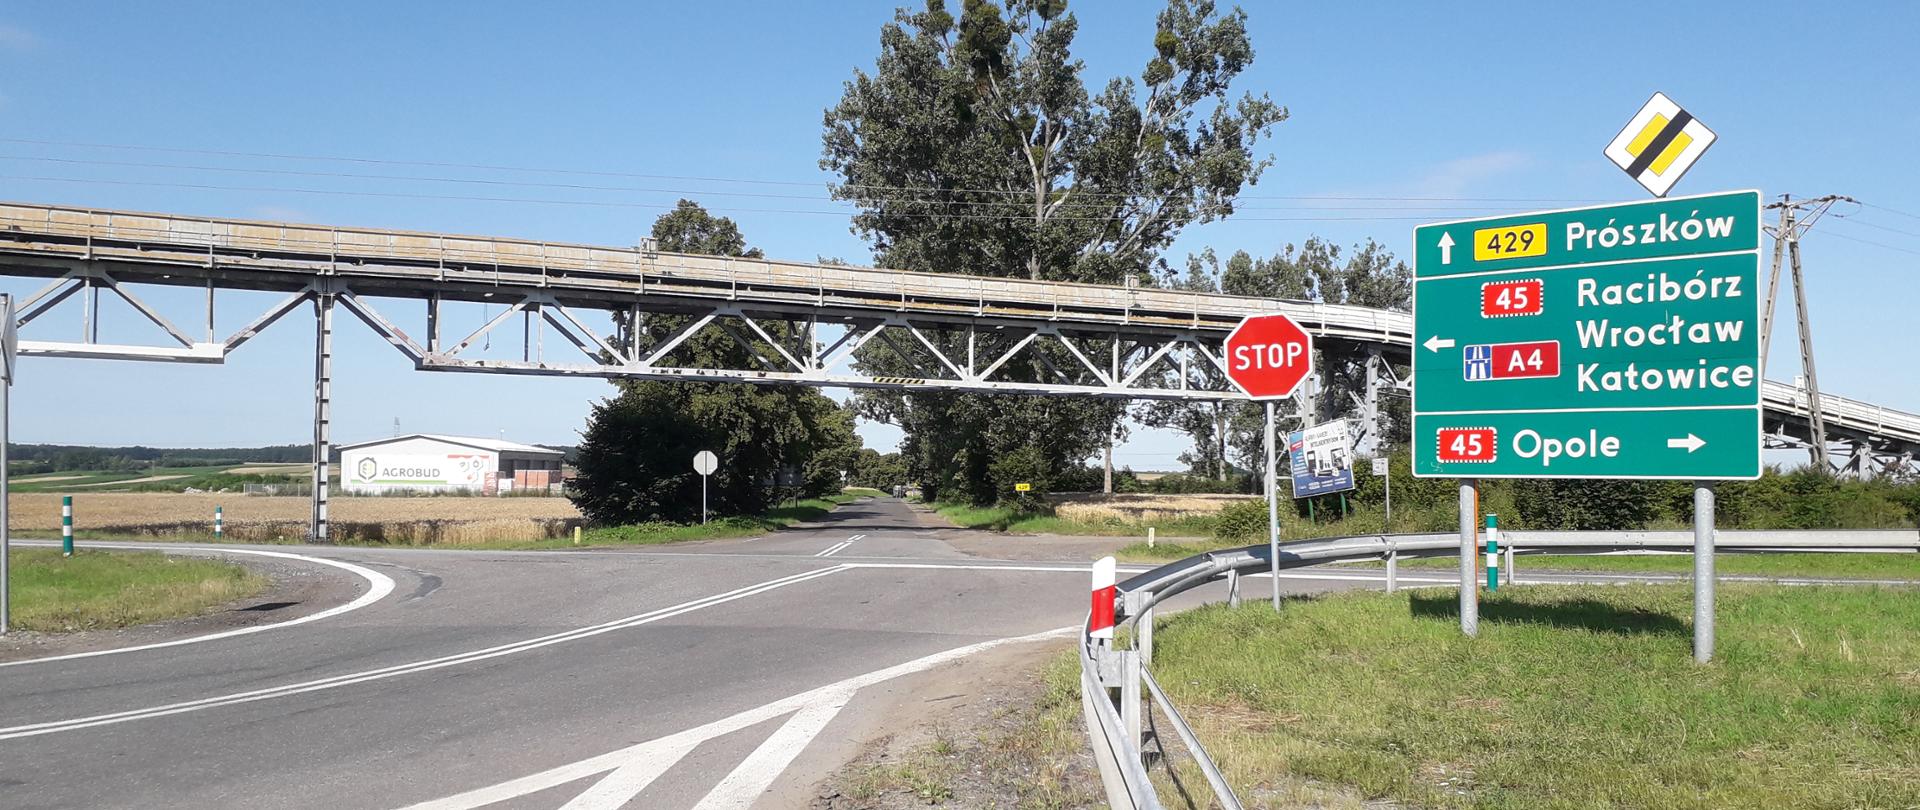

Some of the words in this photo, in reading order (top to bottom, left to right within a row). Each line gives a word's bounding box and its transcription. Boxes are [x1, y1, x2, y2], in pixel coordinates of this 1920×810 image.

[1487, 231, 1534, 254] 429
[1566, 210, 1734, 251] Prószków
[1495, 286, 1528, 310] 45
[1577, 270, 1742, 307] Racibórz
[1576, 315, 1744, 349] Wrocław
[1234, 341, 1303, 371] STOP
[1507, 348, 1543, 372] A4
[1577, 359, 1754, 392] Katowice
[1450, 433, 1482, 456] 45
[1512, 429, 1620, 466] Opole
[382, 467, 441, 478] AGROBUD
